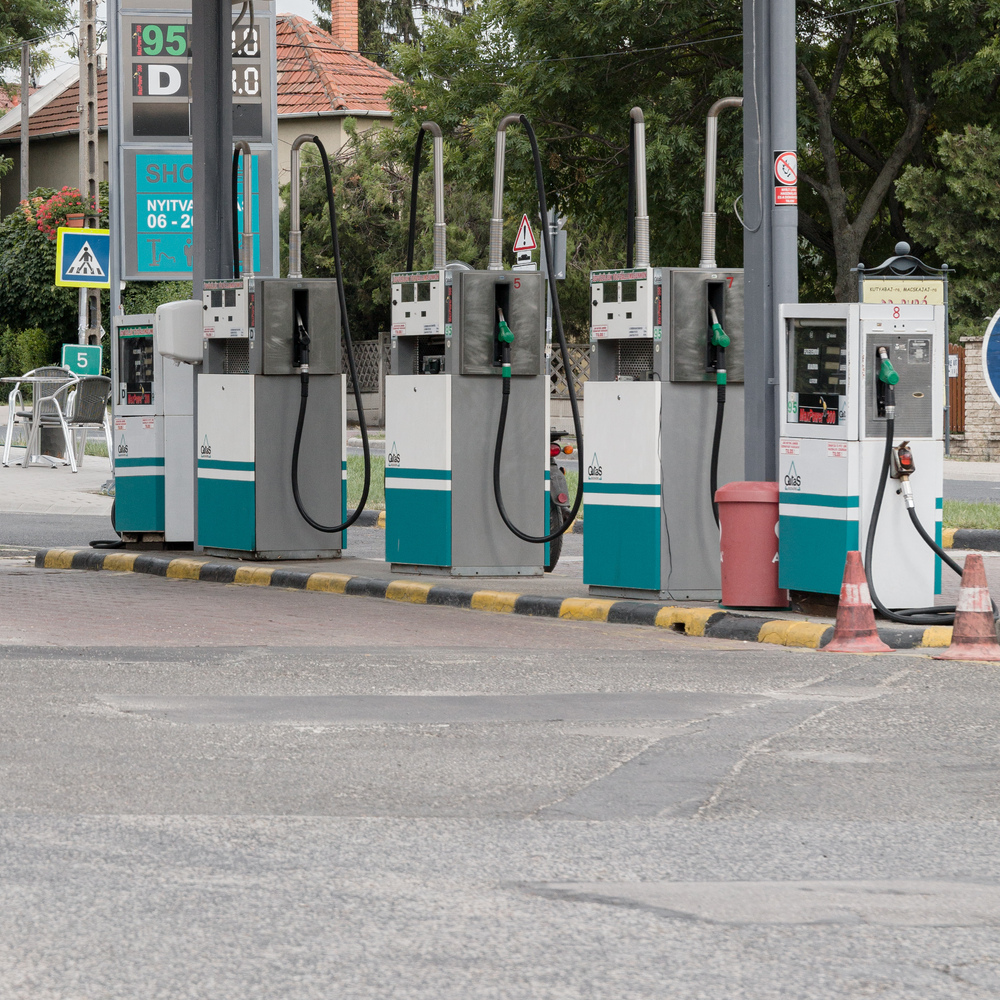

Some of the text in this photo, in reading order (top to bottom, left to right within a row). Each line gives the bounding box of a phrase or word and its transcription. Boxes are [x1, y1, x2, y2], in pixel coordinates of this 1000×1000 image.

[142, 25, 187, 56] 95
[148, 65, 182, 96] D
[146, 163, 193, 184] SHO
[147, 214, 168, 229] 06
[180, 214, 193, 229] 2
[513, 277, 521, 289] 5
[726, 276, 734, 289] 7
[892, 306, 901, 319] 8
[77, 352, 88, 368] 5
[787, 401, 798, 414] 95
